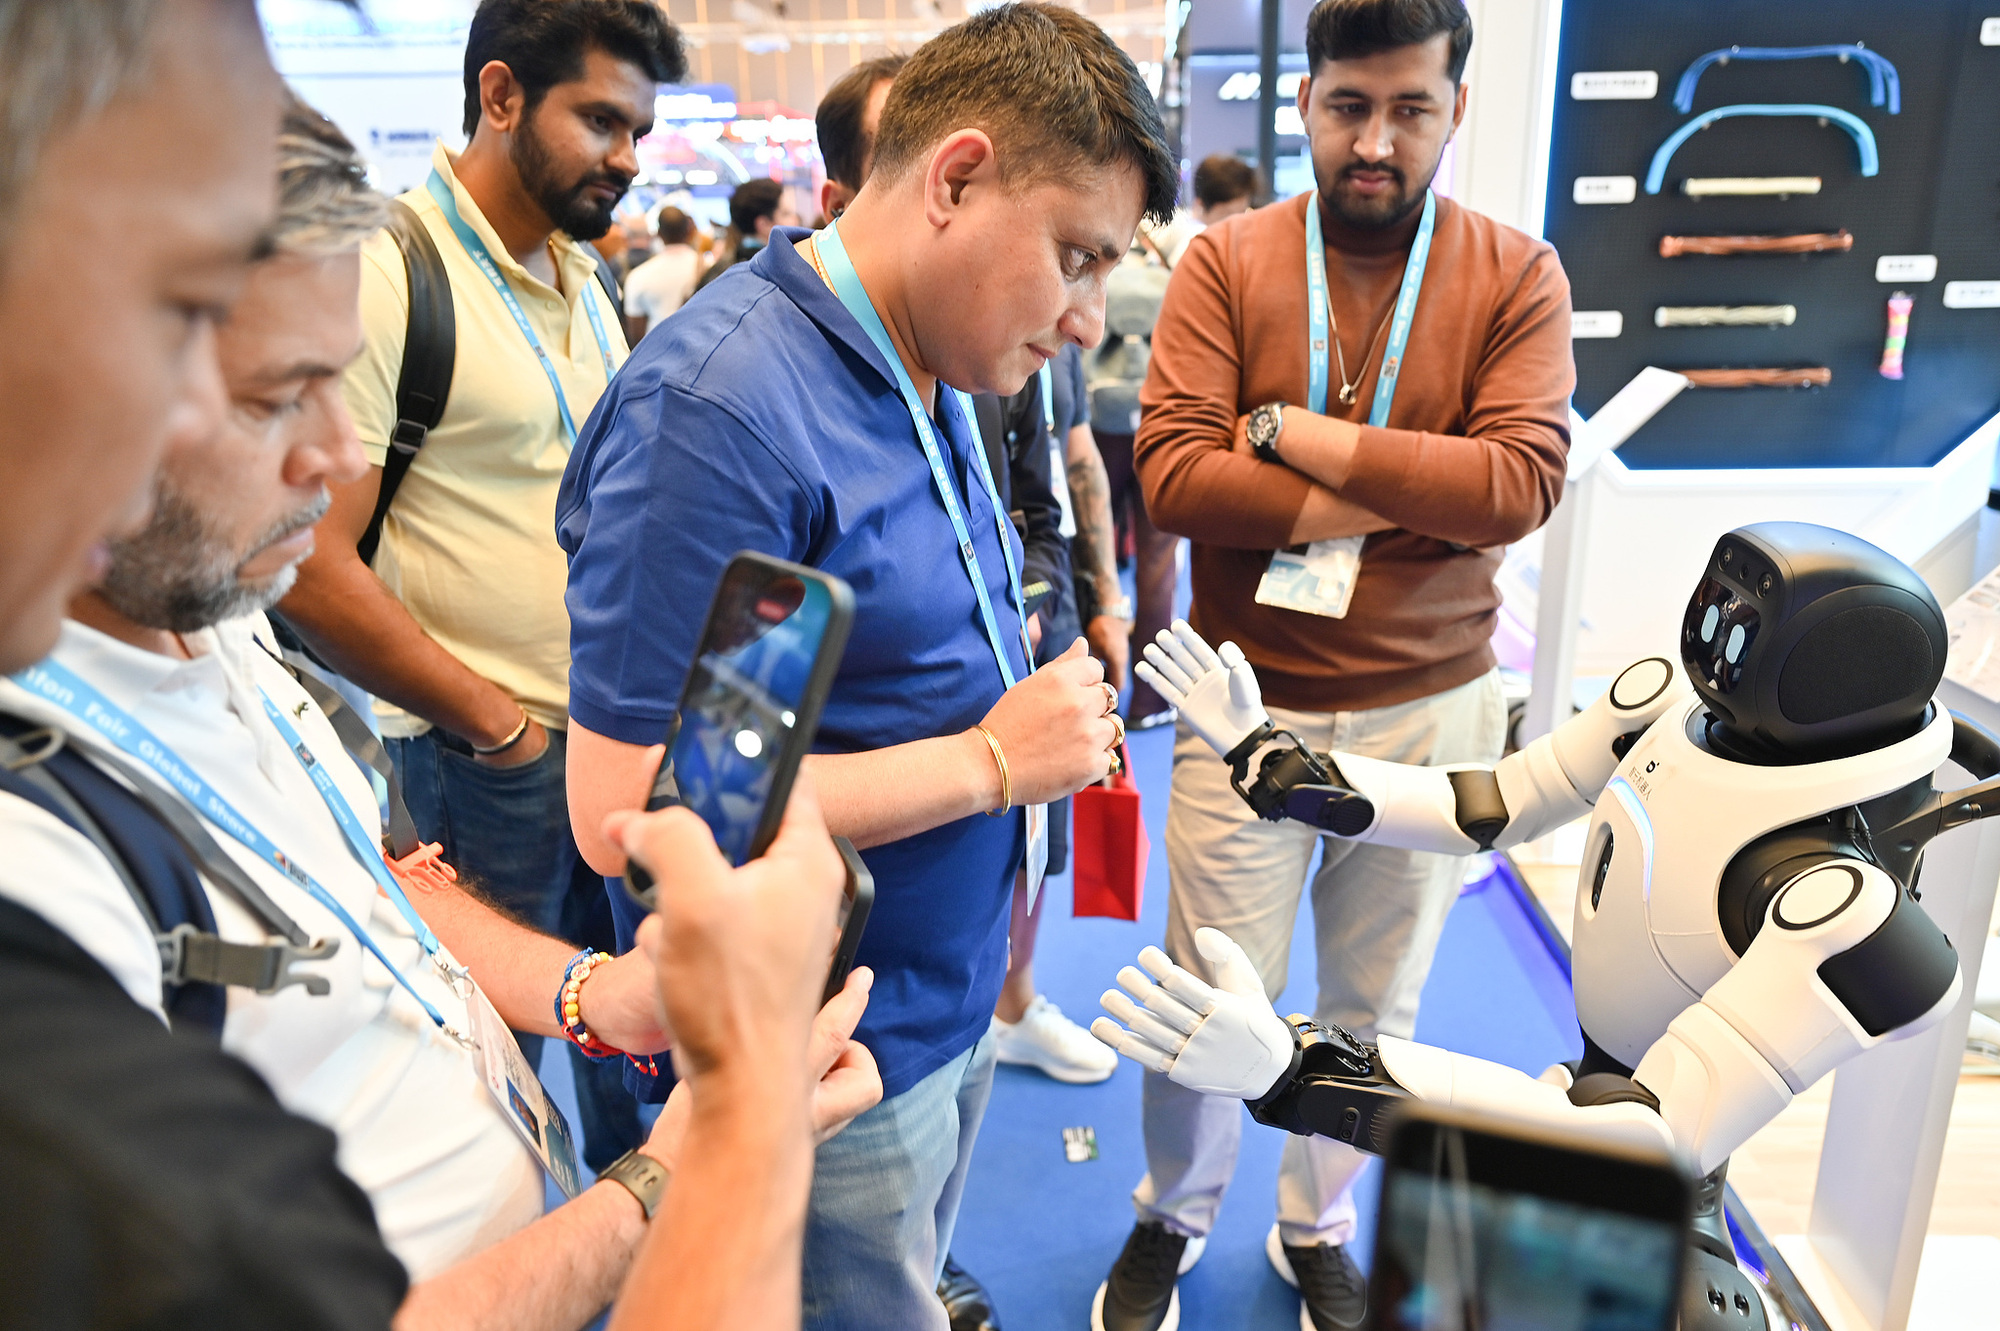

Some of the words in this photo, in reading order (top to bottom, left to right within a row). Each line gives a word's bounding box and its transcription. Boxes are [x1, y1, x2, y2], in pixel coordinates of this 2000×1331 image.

[911, 402, 938, 459] 互利天下
[960, 394, 971, 412] air
[936, 464, 961, 521] 广交世界
[84, 702, 129, 738] Fair
[138, 739, 202, 798] Global
[206, 795, 258, 844] Share
